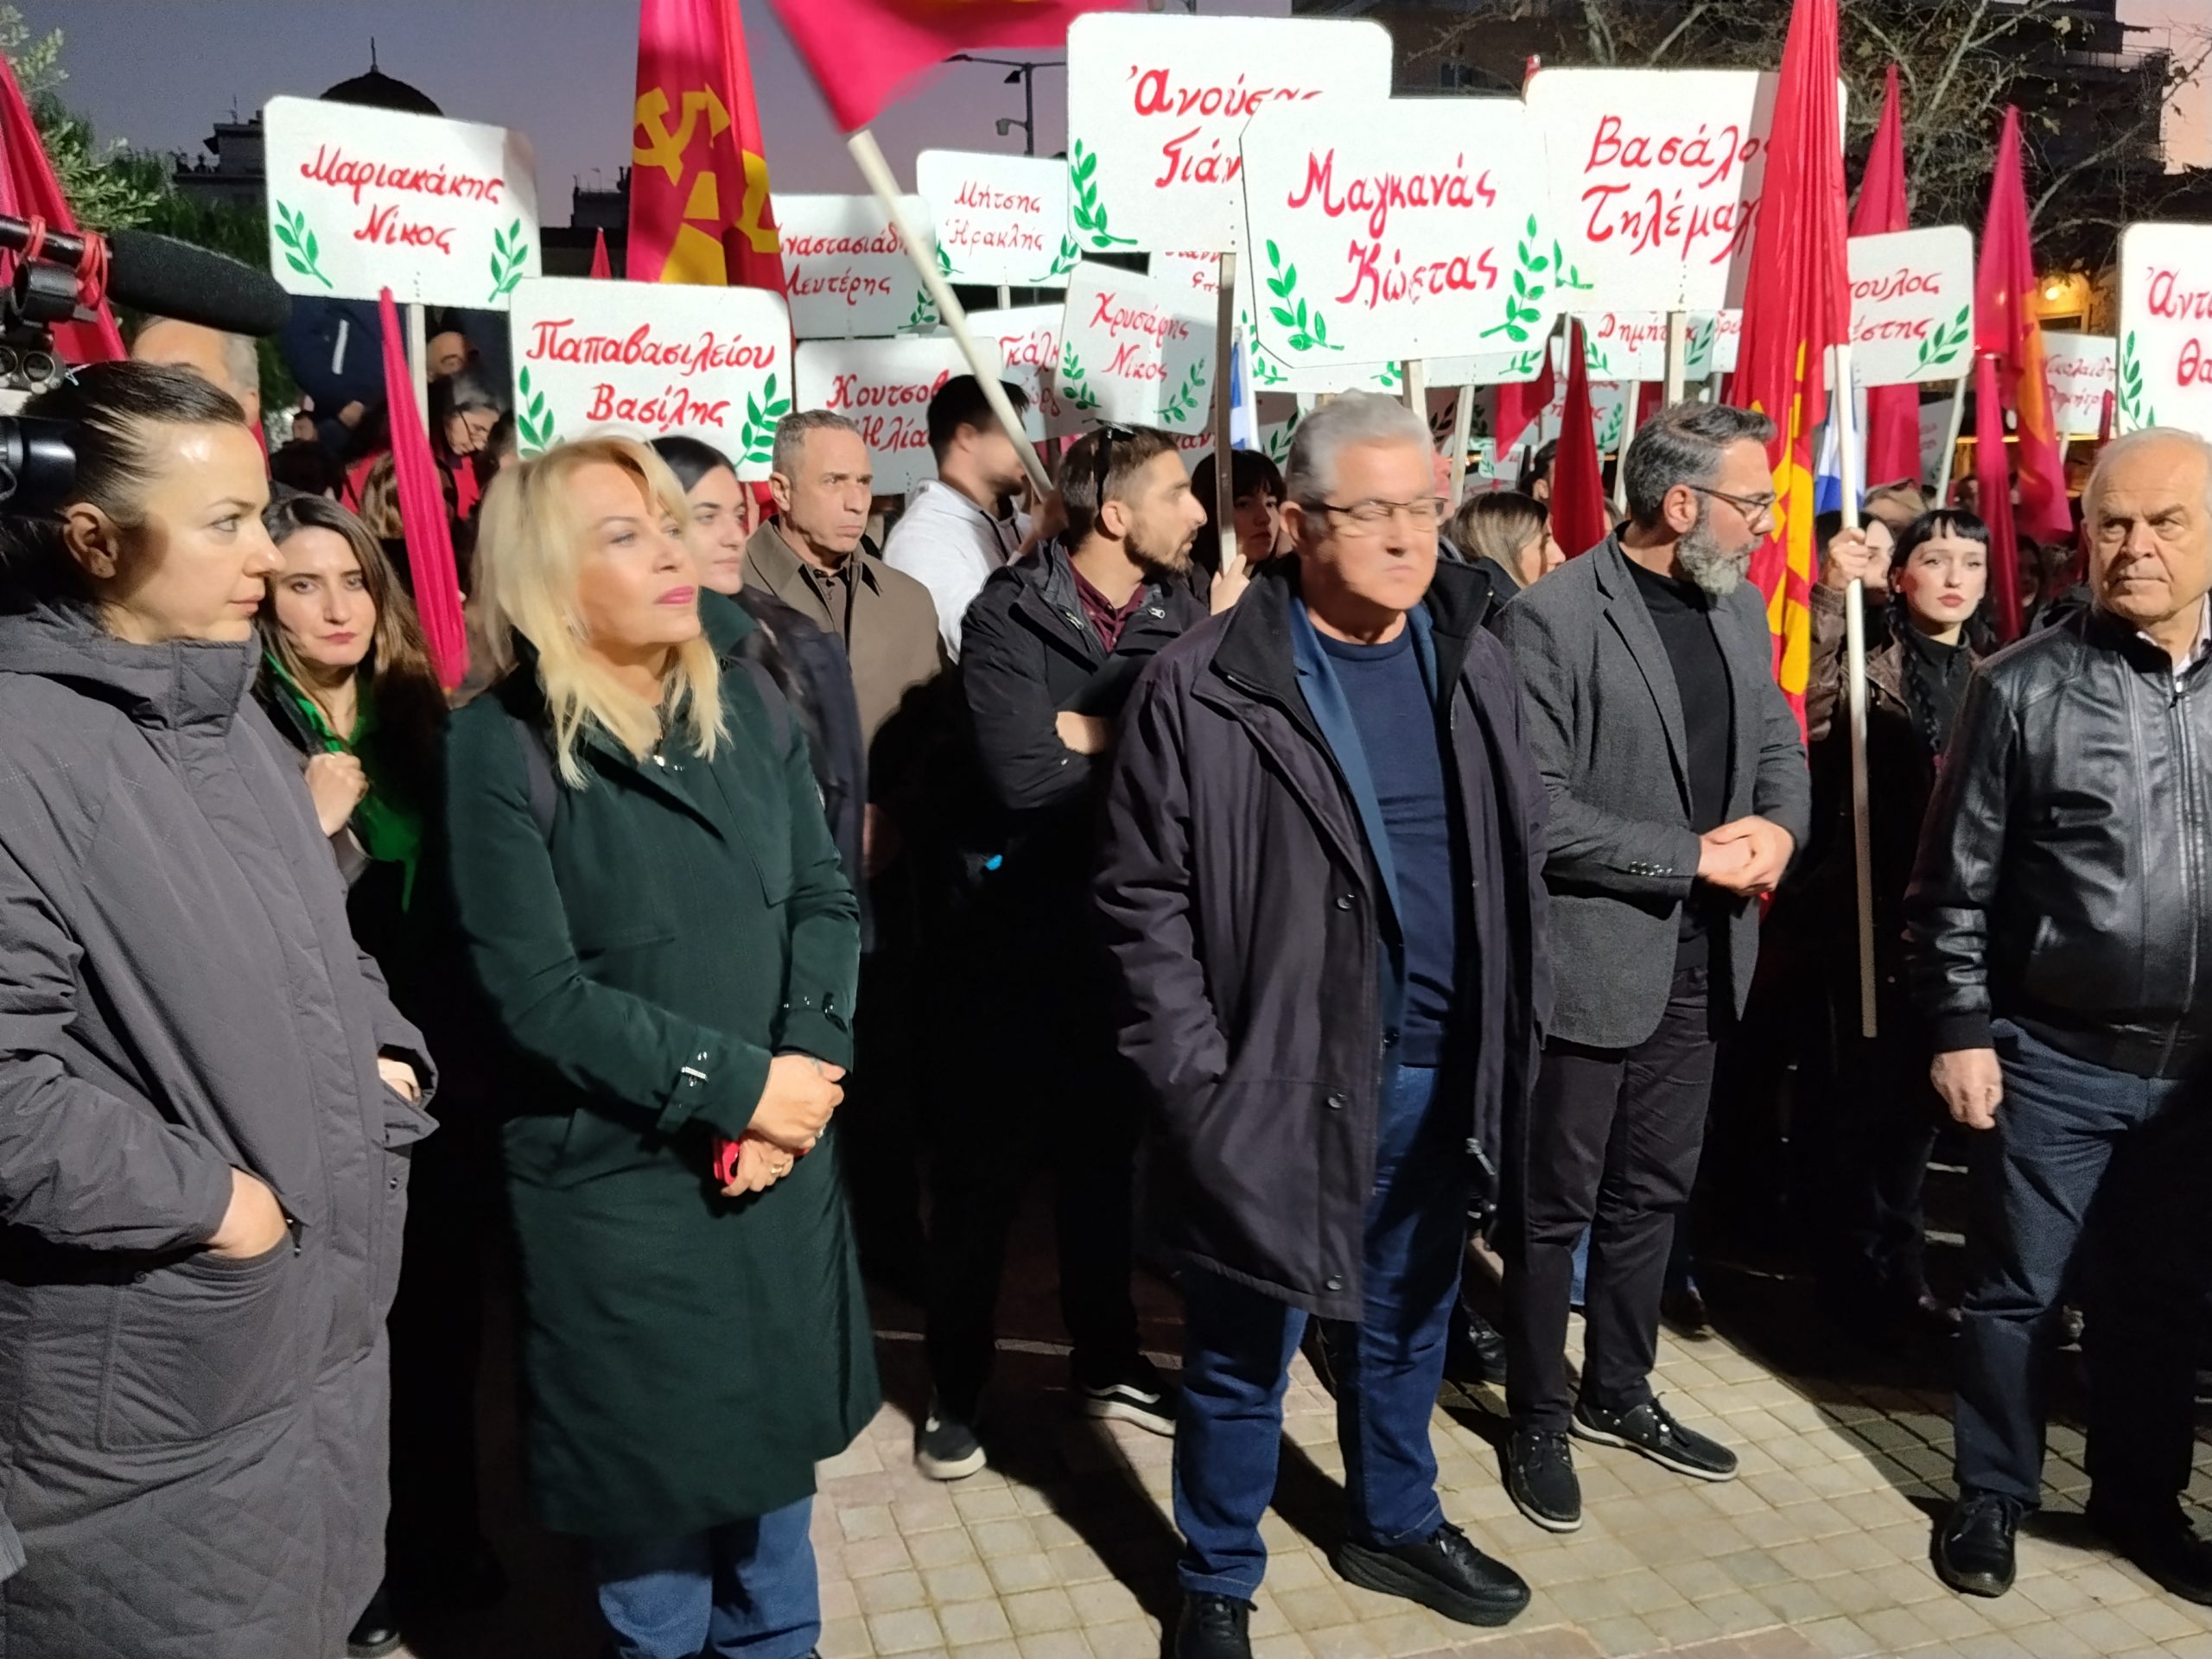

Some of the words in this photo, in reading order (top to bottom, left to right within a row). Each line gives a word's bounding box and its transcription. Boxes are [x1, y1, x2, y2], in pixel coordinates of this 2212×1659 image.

[300, 143, 505, 207] Μαριακάκης
[1154, 125, 1242, 188] Γιάν
[1583, 118, 1771, 189] Βασάλο
[1287, 147, 1497, 239] Μαγκανάς
[1581, 182, 1764, 264] Τηλέμαχ
[353, 203, 457, 255] Νίκος
[1334, 238, 1498, 311] Κώστας
[1849, 267, 1943, 303] ουλος
[525, 317, 775, 377] Παπαβασιλείου
[1851, 315, 1935, 343] έστης
[586, 382, 731, 433] Βασίλης
[825, 368, 950, 410] Κουτσοβ
